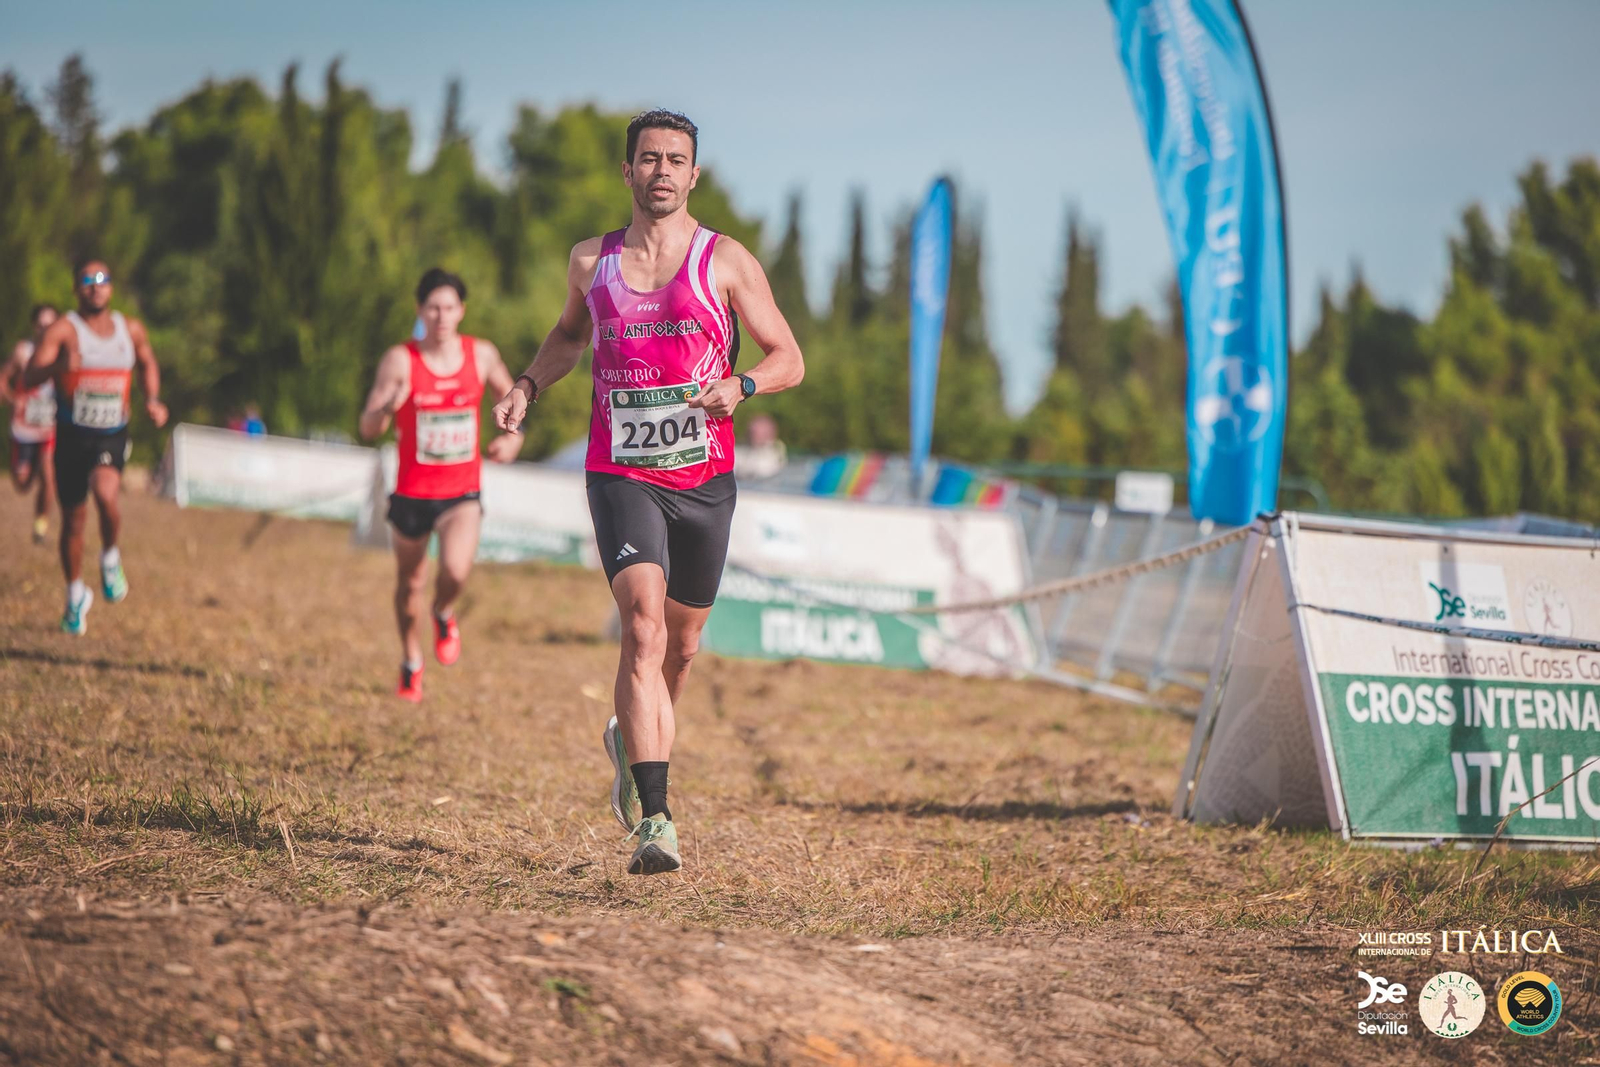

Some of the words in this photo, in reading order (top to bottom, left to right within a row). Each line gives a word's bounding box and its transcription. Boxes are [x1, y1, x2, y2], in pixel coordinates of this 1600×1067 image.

[600, 325, 617, 341] LA
[623, 320, 704, 339] ANTORCHA
[633, 390, 678, 403] ITÁLICA
[621, 415, 700, 449] 2204
[1470, 604, 1506, 621] Sevilla
[1393, 646, 1517, 677] International
[1520, 652, 1573, 679] Cross
[1346, 681, 1456, 727] CROSS
[1463, 685, 1600, 732] INTERNA
